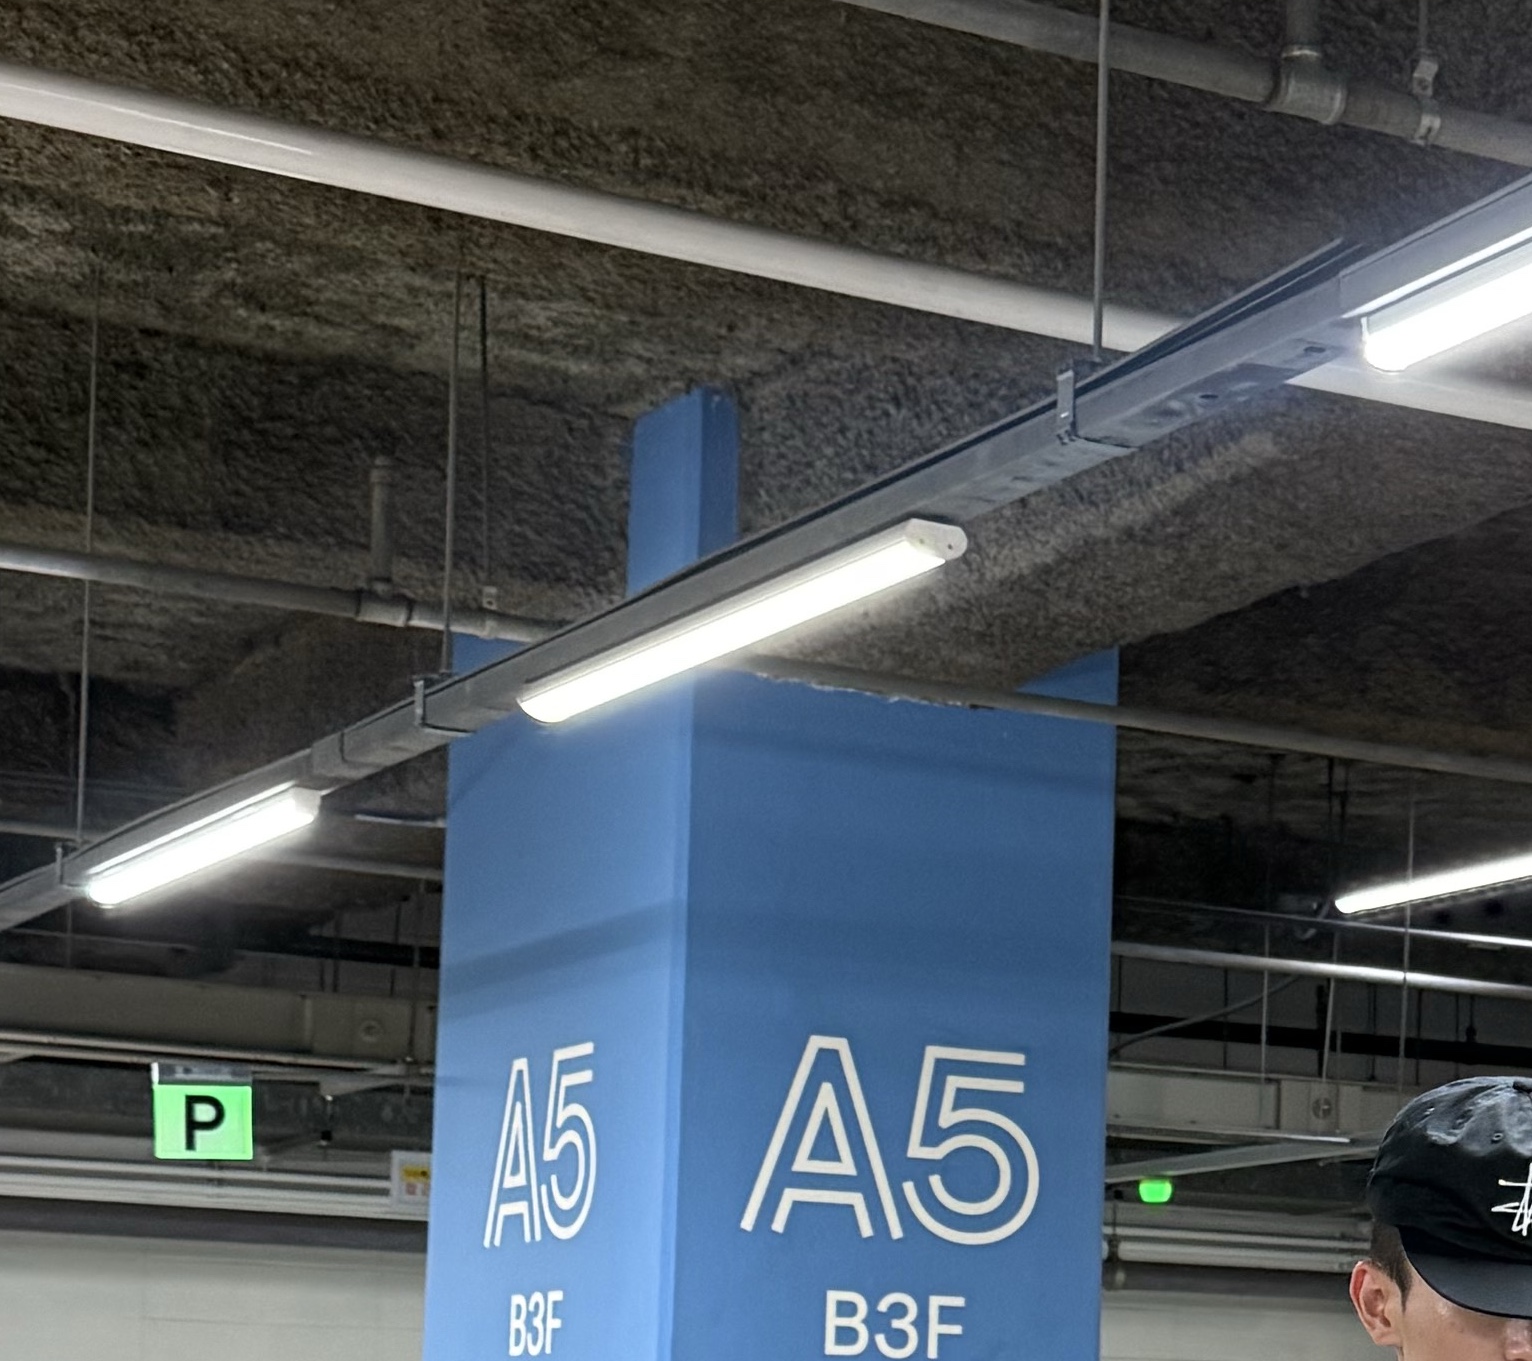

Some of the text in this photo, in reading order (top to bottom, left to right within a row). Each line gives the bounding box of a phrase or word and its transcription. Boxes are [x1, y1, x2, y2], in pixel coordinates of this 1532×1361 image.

[184, 1094, 225, 1151] P
[483, 1041, 598, 1249] A5
[740, 1035, 1040, 1246] A5
[508, 1290, 564, 1357] B3F
[823, 1289, 967, 1360] B3F
